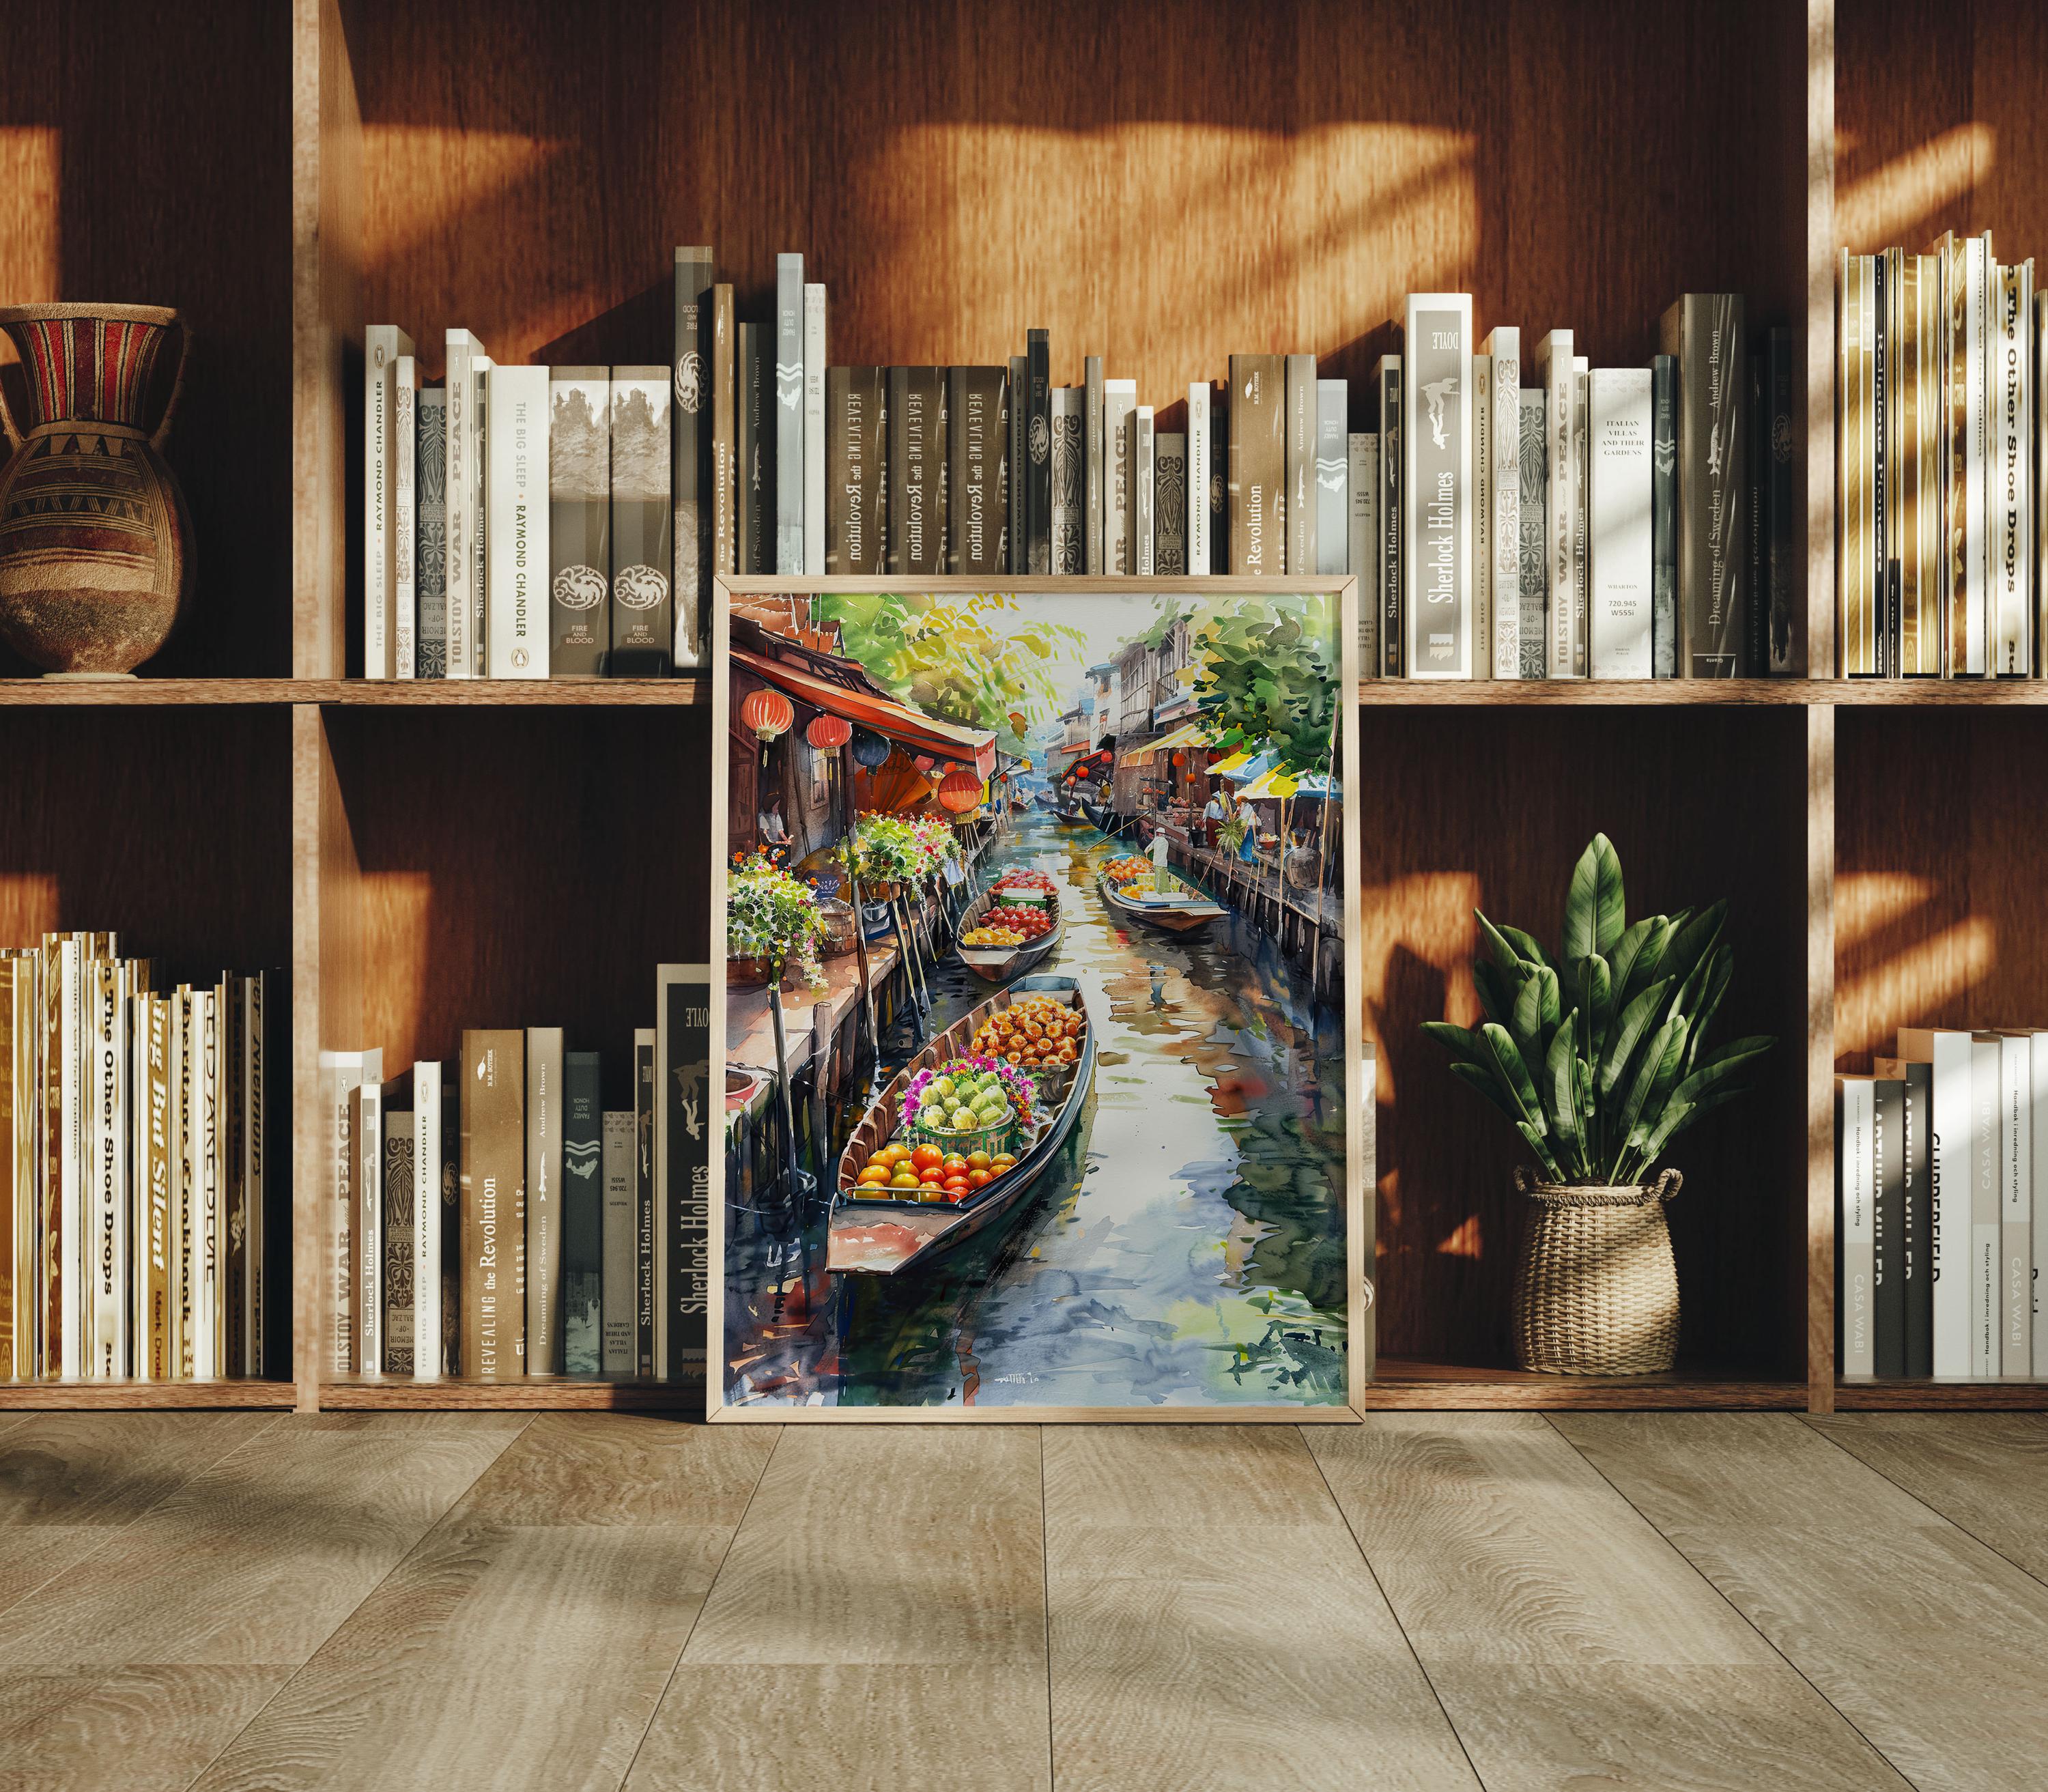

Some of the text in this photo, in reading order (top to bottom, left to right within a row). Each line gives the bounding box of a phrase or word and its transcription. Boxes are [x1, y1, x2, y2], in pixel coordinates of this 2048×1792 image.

[1432, 332, 1459, 350] DOYLE
[1709, 330, 1720, 409] Andrew Brown
[1876, 331, 1884, 454] Religious
[1115, 425, 1126, 575] AR PEACE
[2004, 287, 2018, 593] The Other Shoe Drops
[452, 382, 461, 666] TOLSTOY WAR PEACE
[476, 507, 484, 618] Sherlock Holmes
[516, 402, 526, 637] THE BIG SLEEP RAYMOND CHANDLER
[753, 553, 760, 566] of
[1141, 535, 1150, 575] Holmes
[1247, 485, 1262, 565] Revolution
[1388, 507, 1397, 618] Sherlock Holmes
[1428, 471, 1453, 603] Sherlock Holmes
[1558, 382, 1567, 666] TOLSTOY WAR PEACE
[1708, 489, 1724, 625] Dreaming of Sweden
[685, 1008, 709, 1028] OYLE
[100, 989, 115, 1296] The Other Shoe Drops
[150, 999, 167, 1272] ing But Silent
[1982, 1101, 1991, 1190] CASA WABI
[338, 1104, 351, 1302] WAR PEACE
[641, 1199, 651, 1326] Sherlock Holmes
[681, 1165, 709, 1315] Sherlock Holmes
[155, 1290, 163, 1332] Mark
[365, 1229, 374, 1337] Sherlock Holmes
[479, 1178, 496, 1374] REVEALING the Revolution
[539, 1216, 548, 1346] Dreaming of Sweden
[1854, 1274, 1864, 1353] CASA WABI
[2012, 1257, 2021, 1346] CASA WABI
